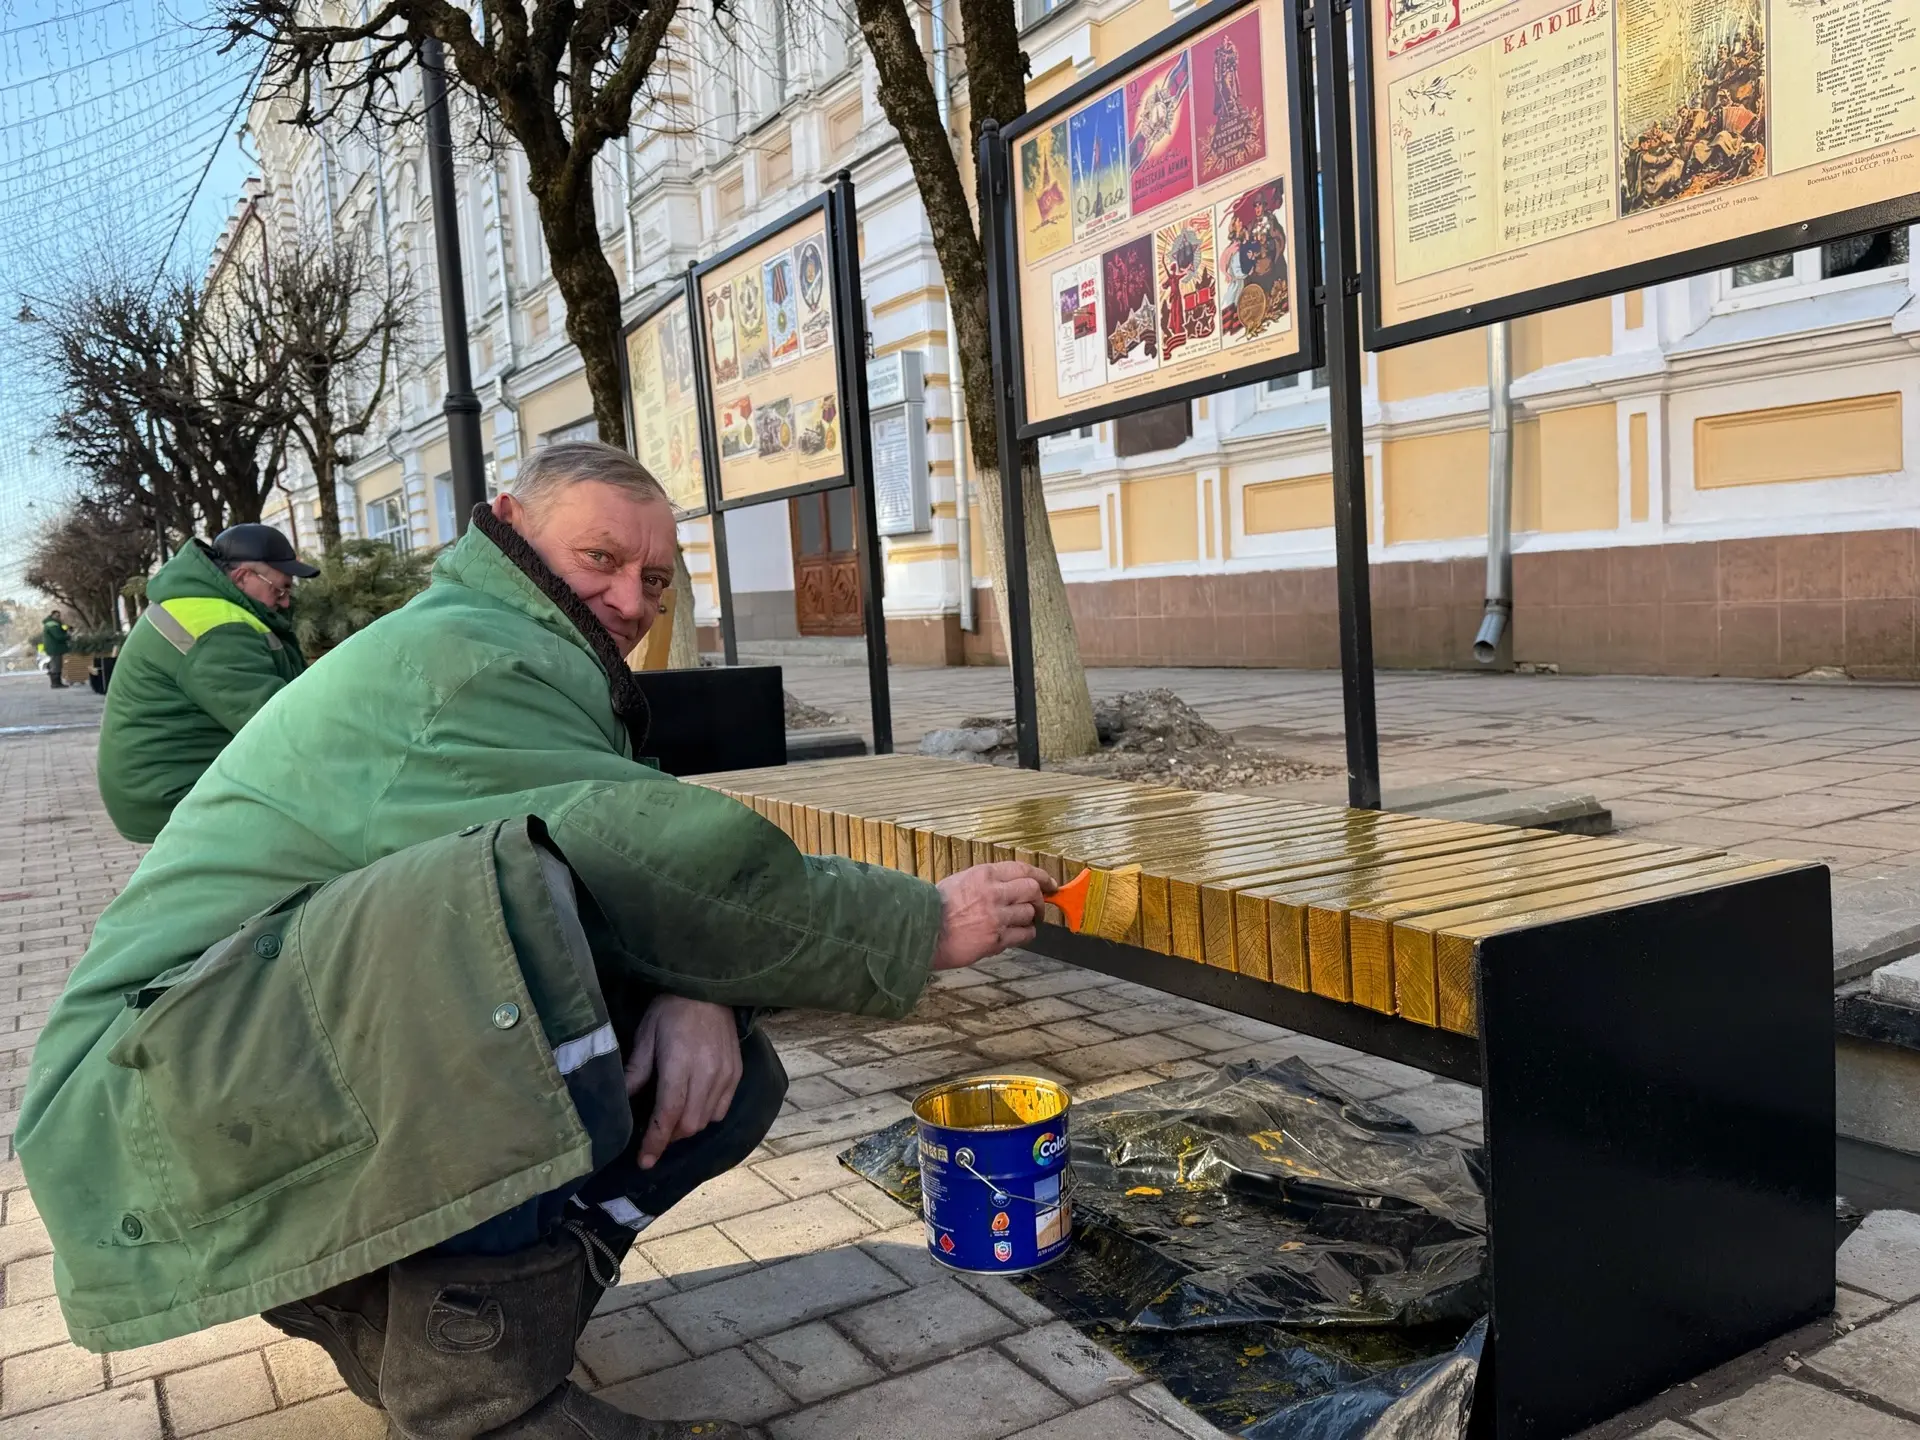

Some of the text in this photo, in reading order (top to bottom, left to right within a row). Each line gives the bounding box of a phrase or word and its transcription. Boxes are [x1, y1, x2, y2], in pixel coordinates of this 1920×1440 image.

[1392, 13, 1448, 45] КАТЮША
[1503, 0, 1597, 54] КАТЮША
[1812, 8, 1840, 22] ТУМАНЫ
[1807, 153, 1915, 186] Воениздат НКО СССР. 1943 год.
[1821, 160, 1854, 174] Художник
[1855, 150, 1890, 165] Щербаков
[1627, 220, 1664, 234] Министерство
[1713, 202, 1731, 212] СССР.
[1733, 196, 1746, 206] 1949
[1660, 207, 1686, 219] Художник
[1687, 199, 1715, 211] Бортников
